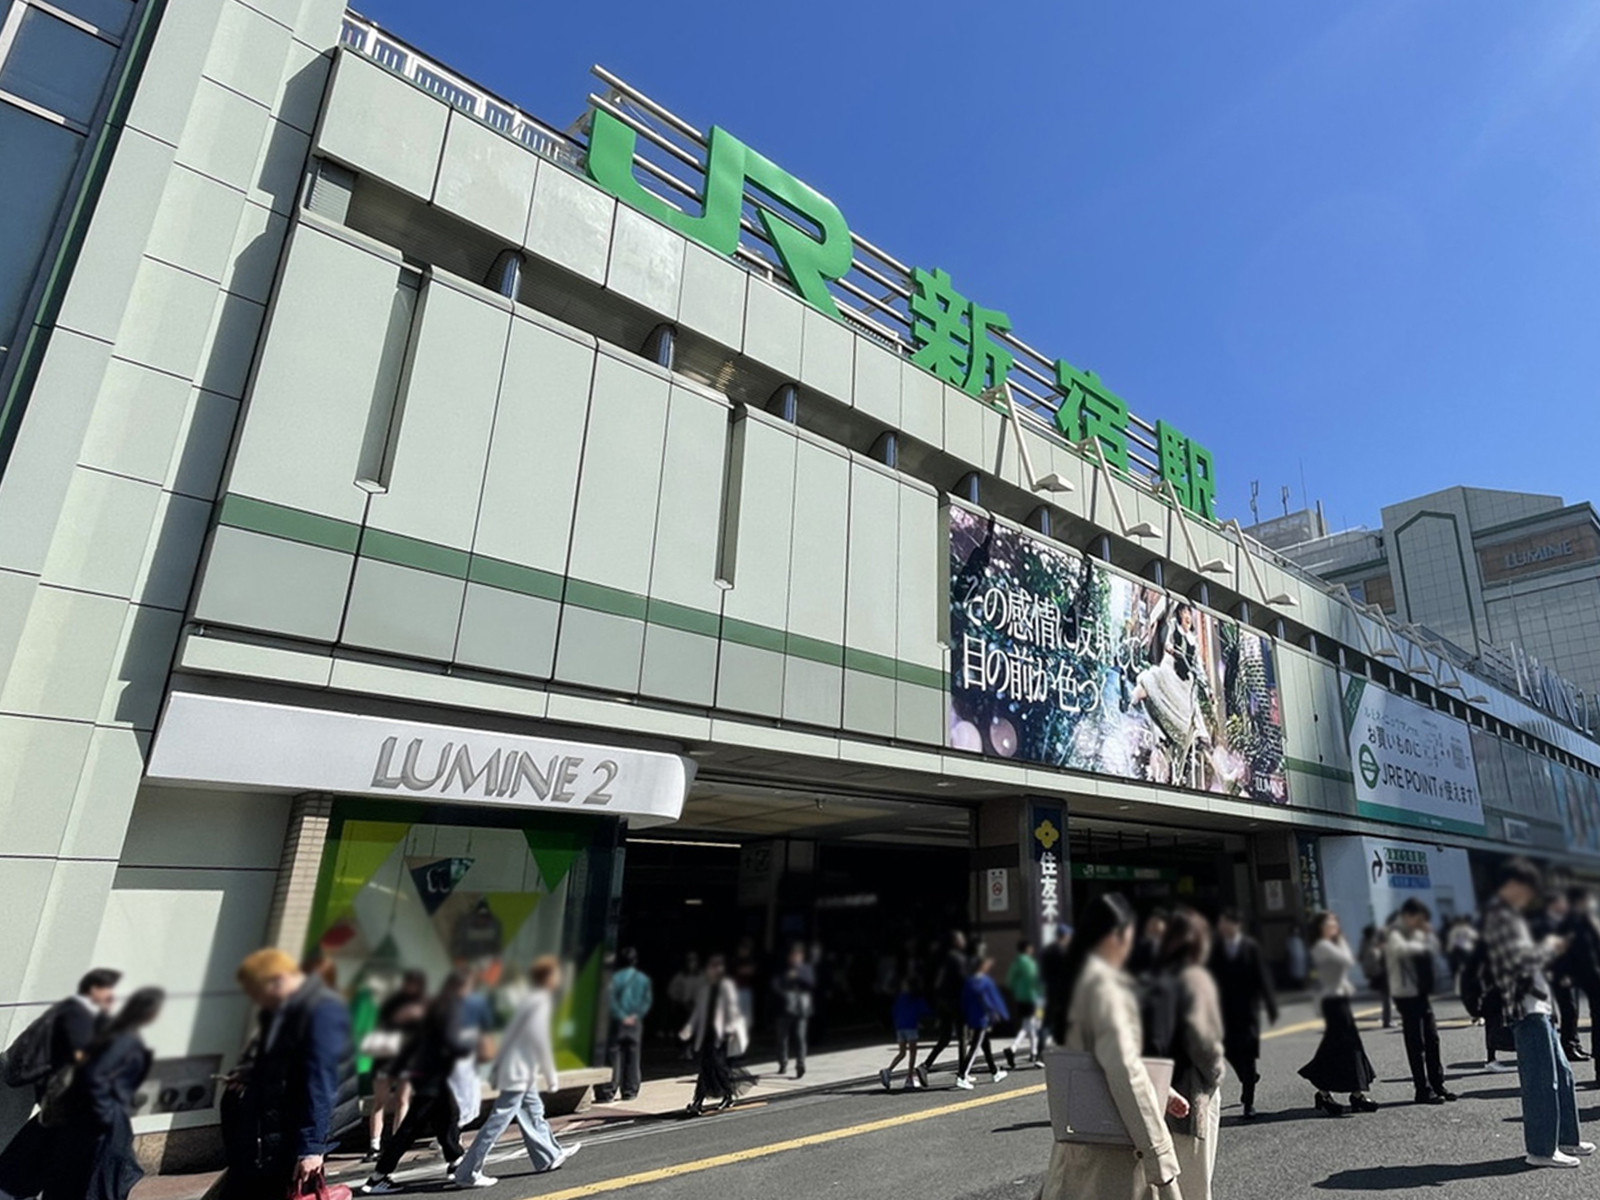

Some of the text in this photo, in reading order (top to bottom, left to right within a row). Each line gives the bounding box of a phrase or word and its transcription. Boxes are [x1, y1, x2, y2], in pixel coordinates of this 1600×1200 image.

[586, 108, 1216, 522] JR 新宿駅
[1504, 540, 1573, 568] LUMINE
[371, 736, 619, 805] LUMINE 2
[1382, 763, 1405, 789] JRE
[1040, 851, 1058, 946] 住友不
